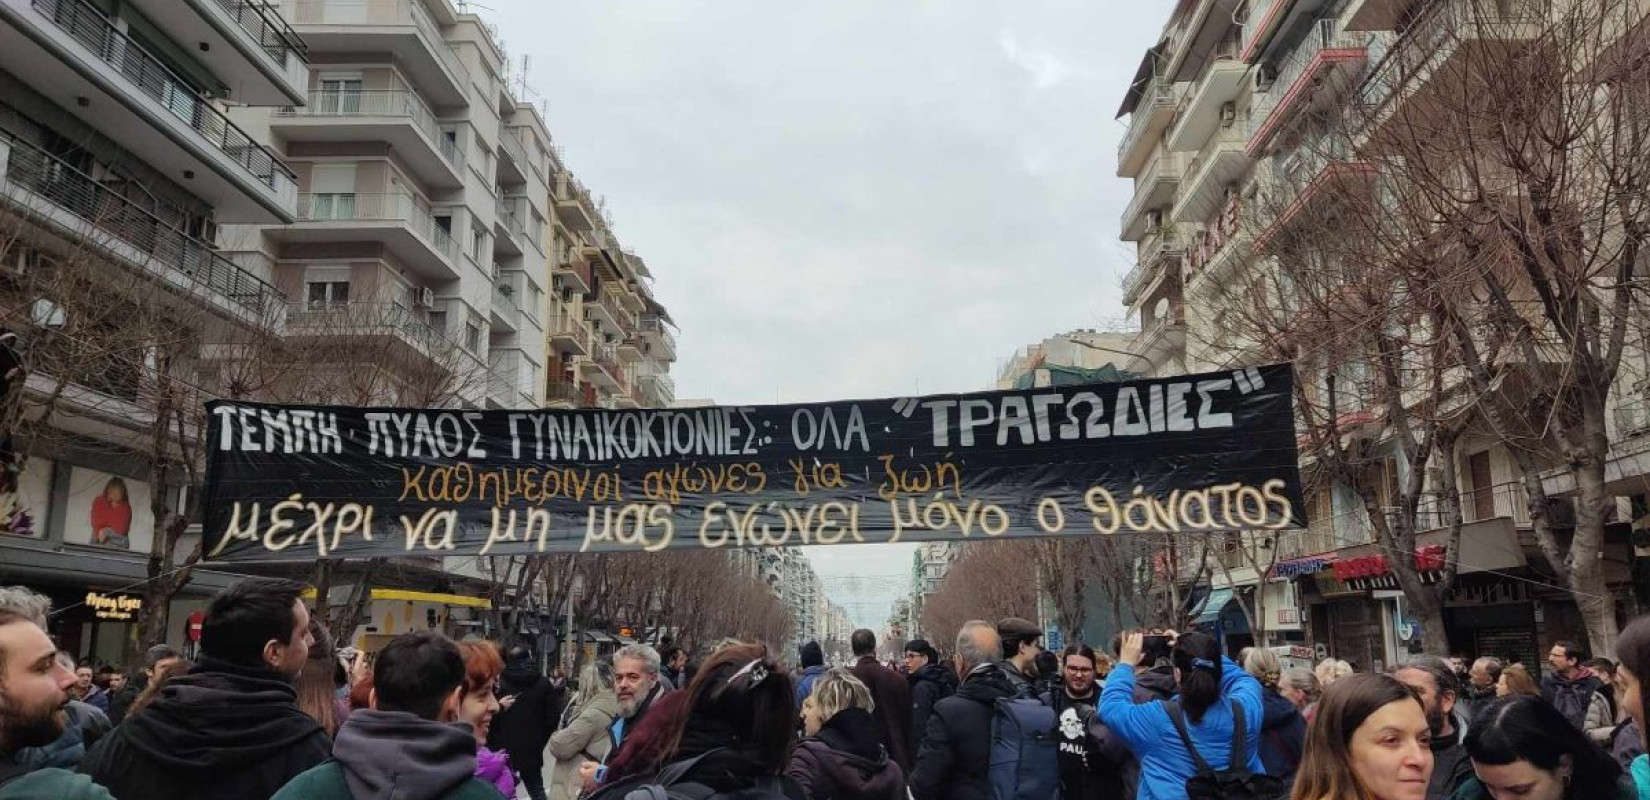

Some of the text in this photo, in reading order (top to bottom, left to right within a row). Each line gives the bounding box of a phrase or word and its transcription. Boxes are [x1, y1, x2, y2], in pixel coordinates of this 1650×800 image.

[214, 406, 341, 453] ΤΕΜΠΗ
[364, 412, 487, 458] ΠΥΛΟΣ
[791, 406, 870, 452] ΟΛΑ
[208, 479, 1292, 557] μέχρι να μη μας ενώνει μόνο ο θάνατος
